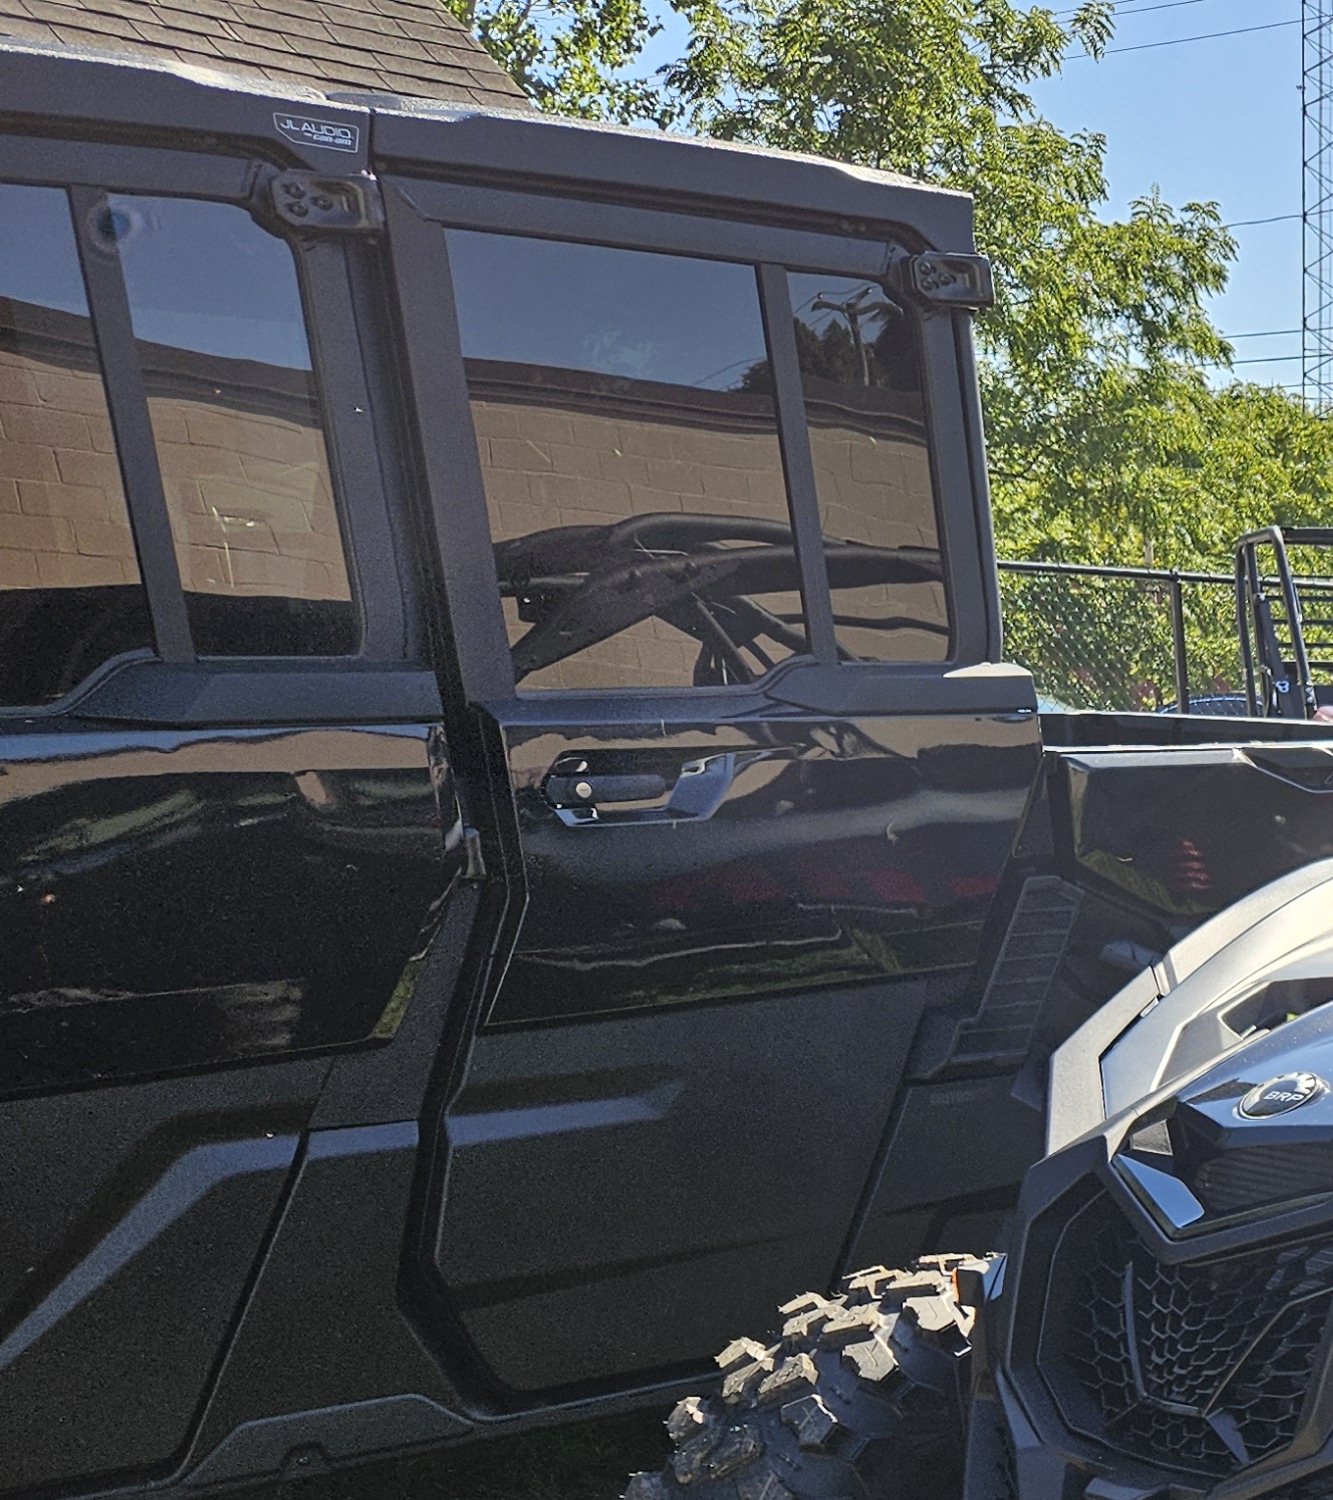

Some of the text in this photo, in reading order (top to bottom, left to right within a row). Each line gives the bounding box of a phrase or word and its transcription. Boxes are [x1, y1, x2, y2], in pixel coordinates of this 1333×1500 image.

[280, 119, 352, 138] JL AUDIO
[1263, 1090, 1305, 1103] BRP
